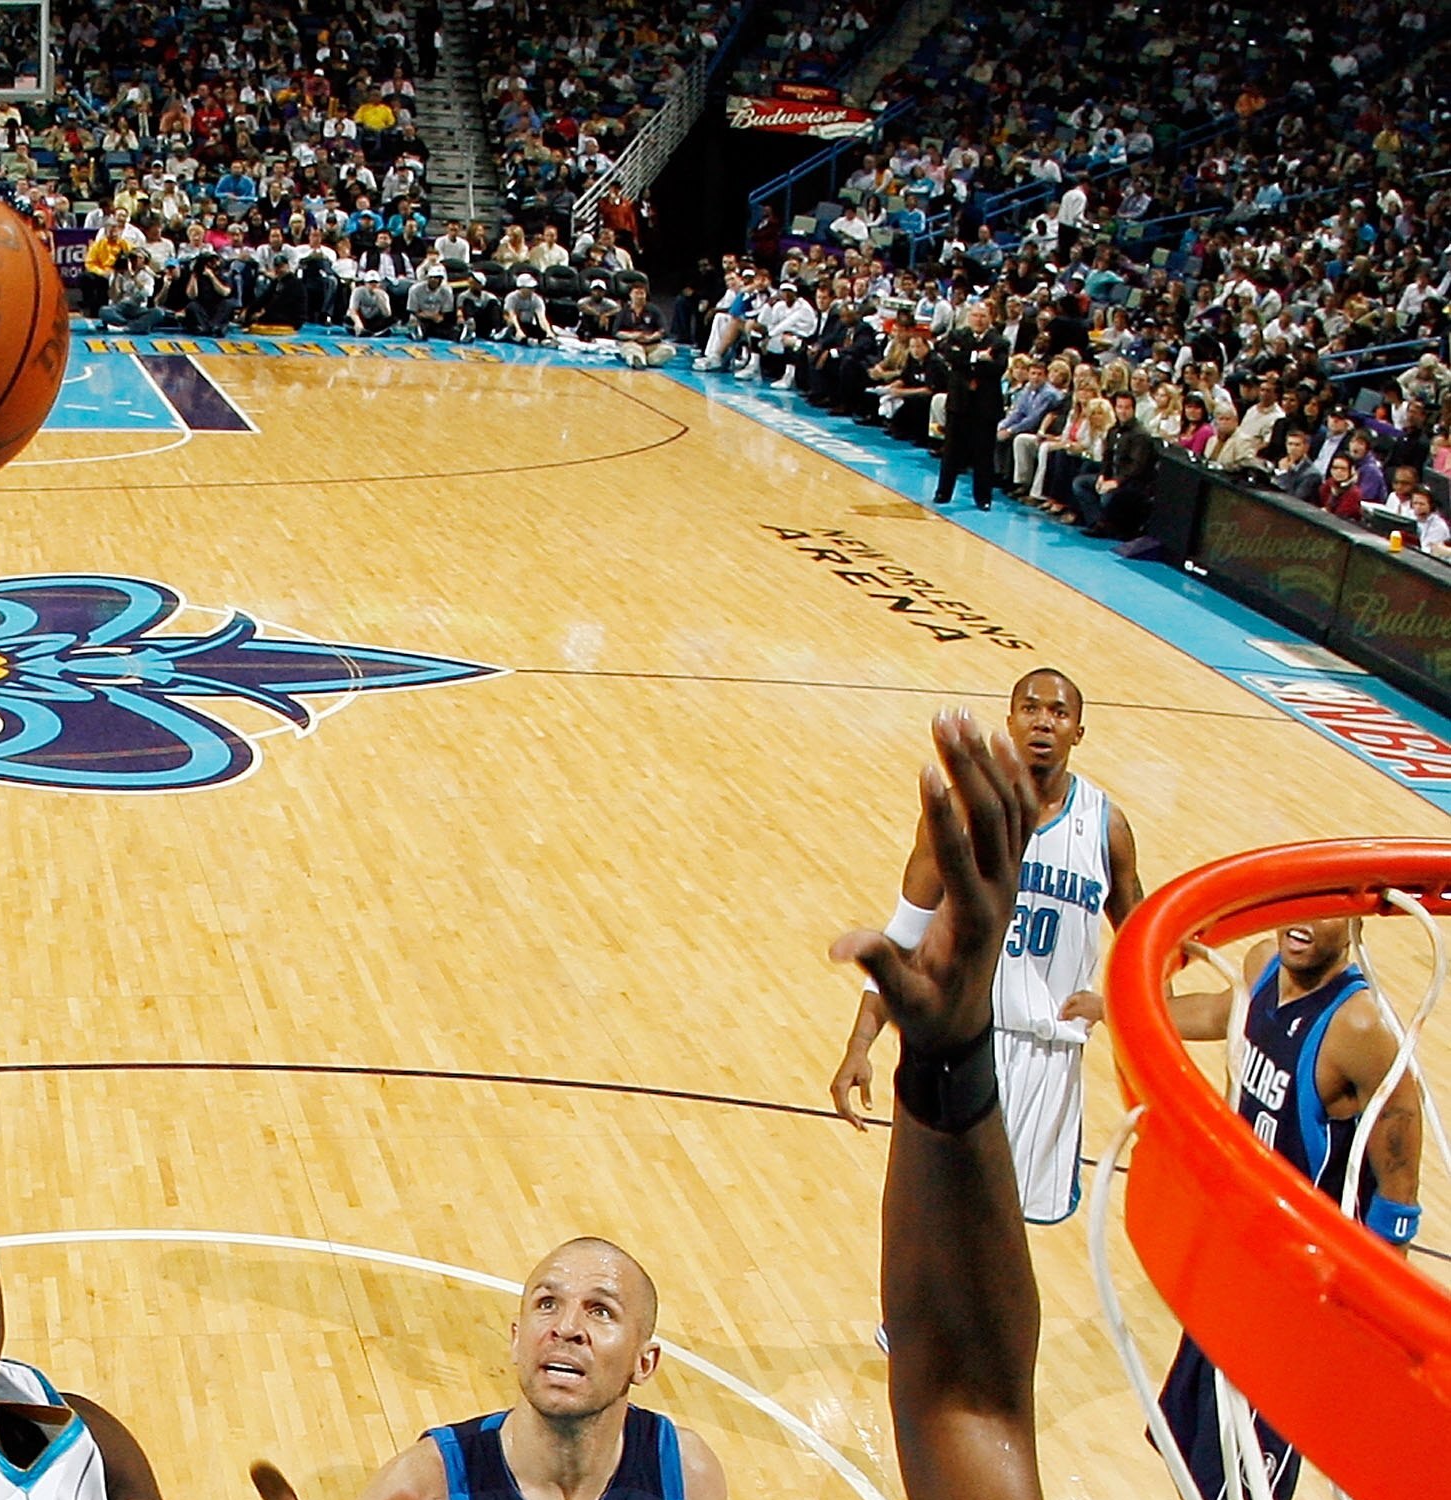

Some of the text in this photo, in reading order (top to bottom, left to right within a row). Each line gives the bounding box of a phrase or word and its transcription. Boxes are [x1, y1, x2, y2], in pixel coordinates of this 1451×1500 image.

[729, 107, 847, 129] Budweiser
[759, 524, 972, 643] ARENA
[812, 528, 1036, 651] NEW ORLEANS
[1005, 904, 1061, 958] 30
